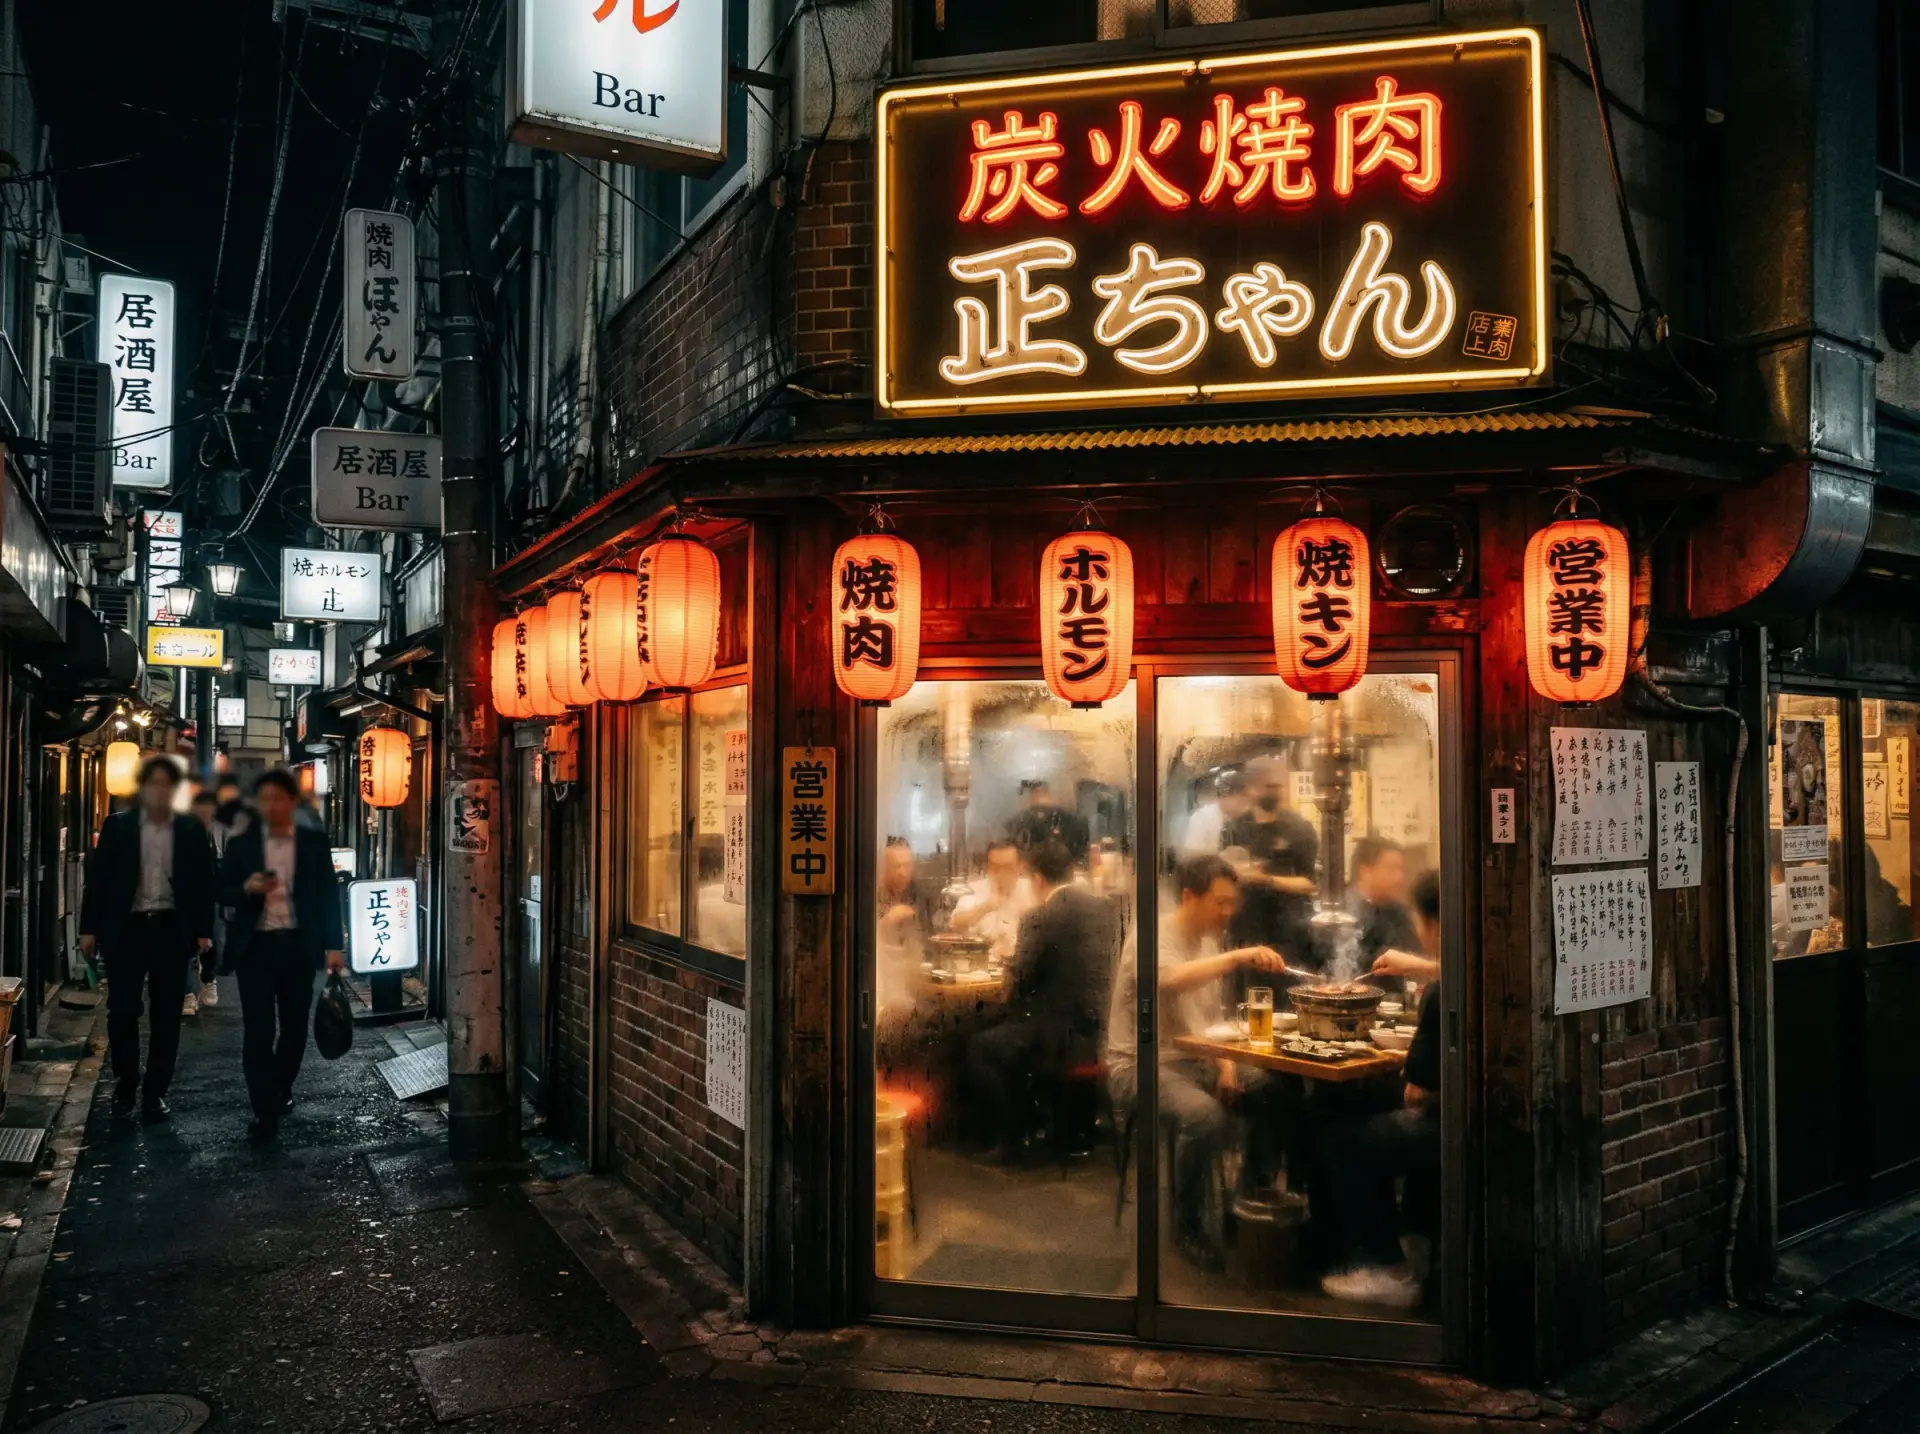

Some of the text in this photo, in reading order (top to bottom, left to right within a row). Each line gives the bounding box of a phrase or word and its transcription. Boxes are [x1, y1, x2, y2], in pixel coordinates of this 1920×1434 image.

[592, 70, 666, 118] Bar
[957, 74, 1444, 223] 炭火焼肉
[367, 222, 393, 270] 焼肉
[939, 220, 1456, 385] 正ちゃん
[115, 292, 157, 414] 居酒屋
[113, 448, 158, 470] Bar
[331, 444, 432, 479] 居酒屋
[355, 486, 410, 512] Bar
[292, 557, 372, 578] 焼ホルモン
[839, 557, 899, 671] 焼肉
[1059, 545, 1111, 684] ホルモン
[1294, 537, 1355, 670] 焼キン
[1547, 537, 1607, 682] 営業中
[789, 760, 829, 887] 営業中
[366, 889, 392, 966] 正ちゃん
